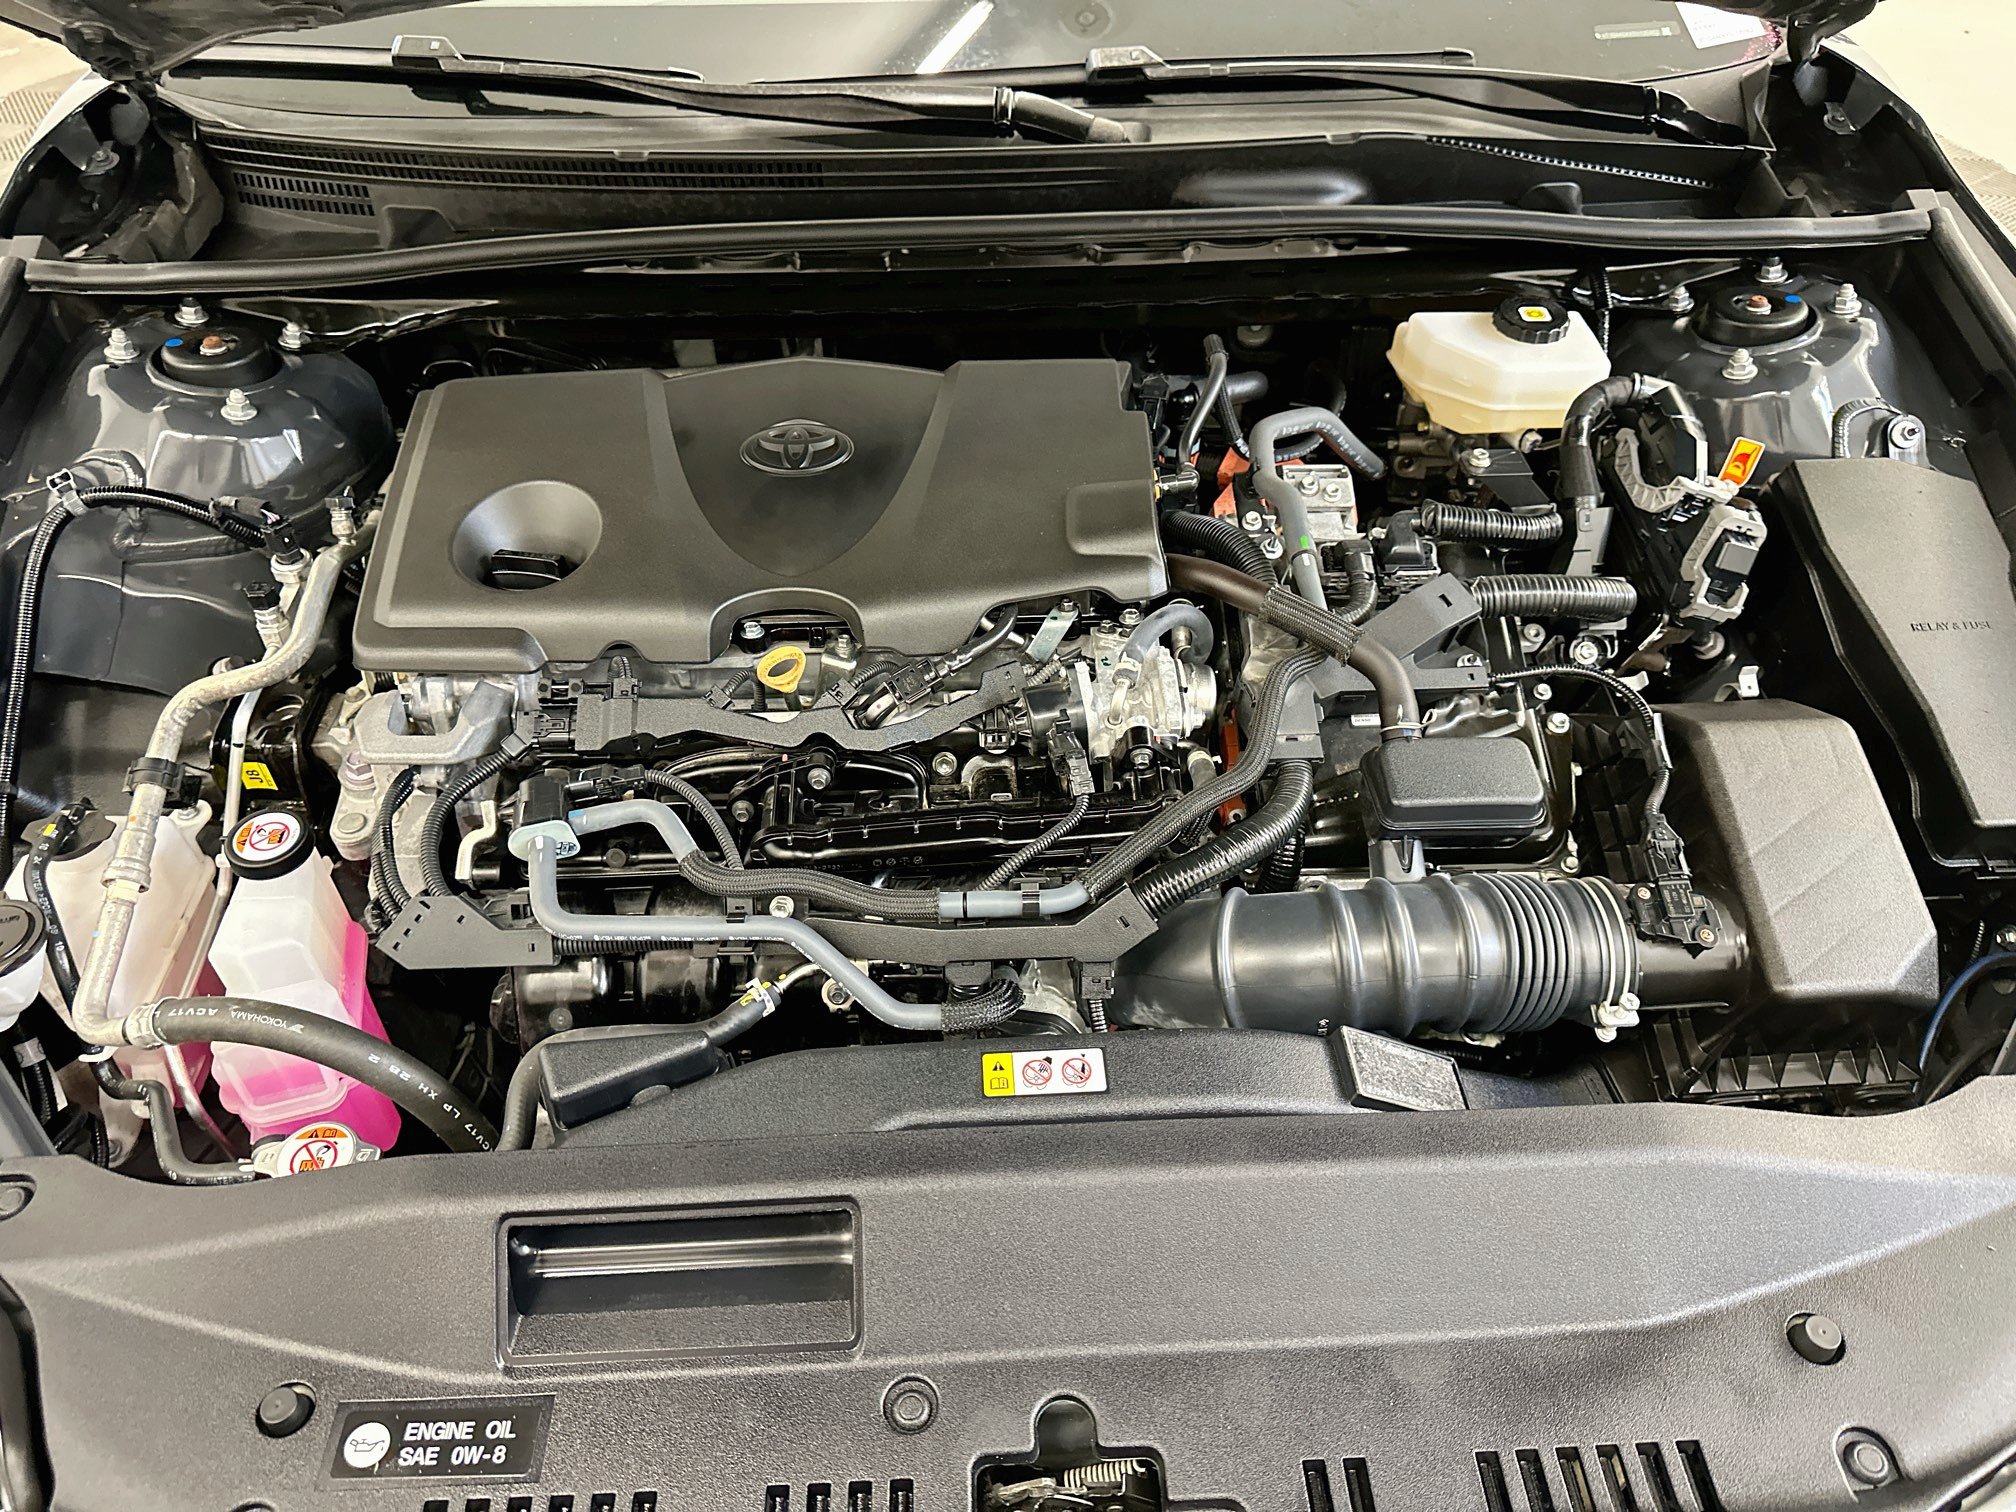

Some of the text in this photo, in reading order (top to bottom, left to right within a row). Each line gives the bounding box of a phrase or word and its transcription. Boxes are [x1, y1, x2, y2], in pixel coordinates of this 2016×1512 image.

[1910, 622, 1949, 632] RELAY
[1952, 622, 1961, 631] &
[168, 1008, 219, 1016] ACV17
[230, 1010, 287, 1028] YOKOHAMA
[367, 1053, 493, 1152] CV17 LP XH 2B 2
[404, 1420, 517, 1441] ENGINE OIL
[398, 1445, 507, 1466] SAE 0W-8
